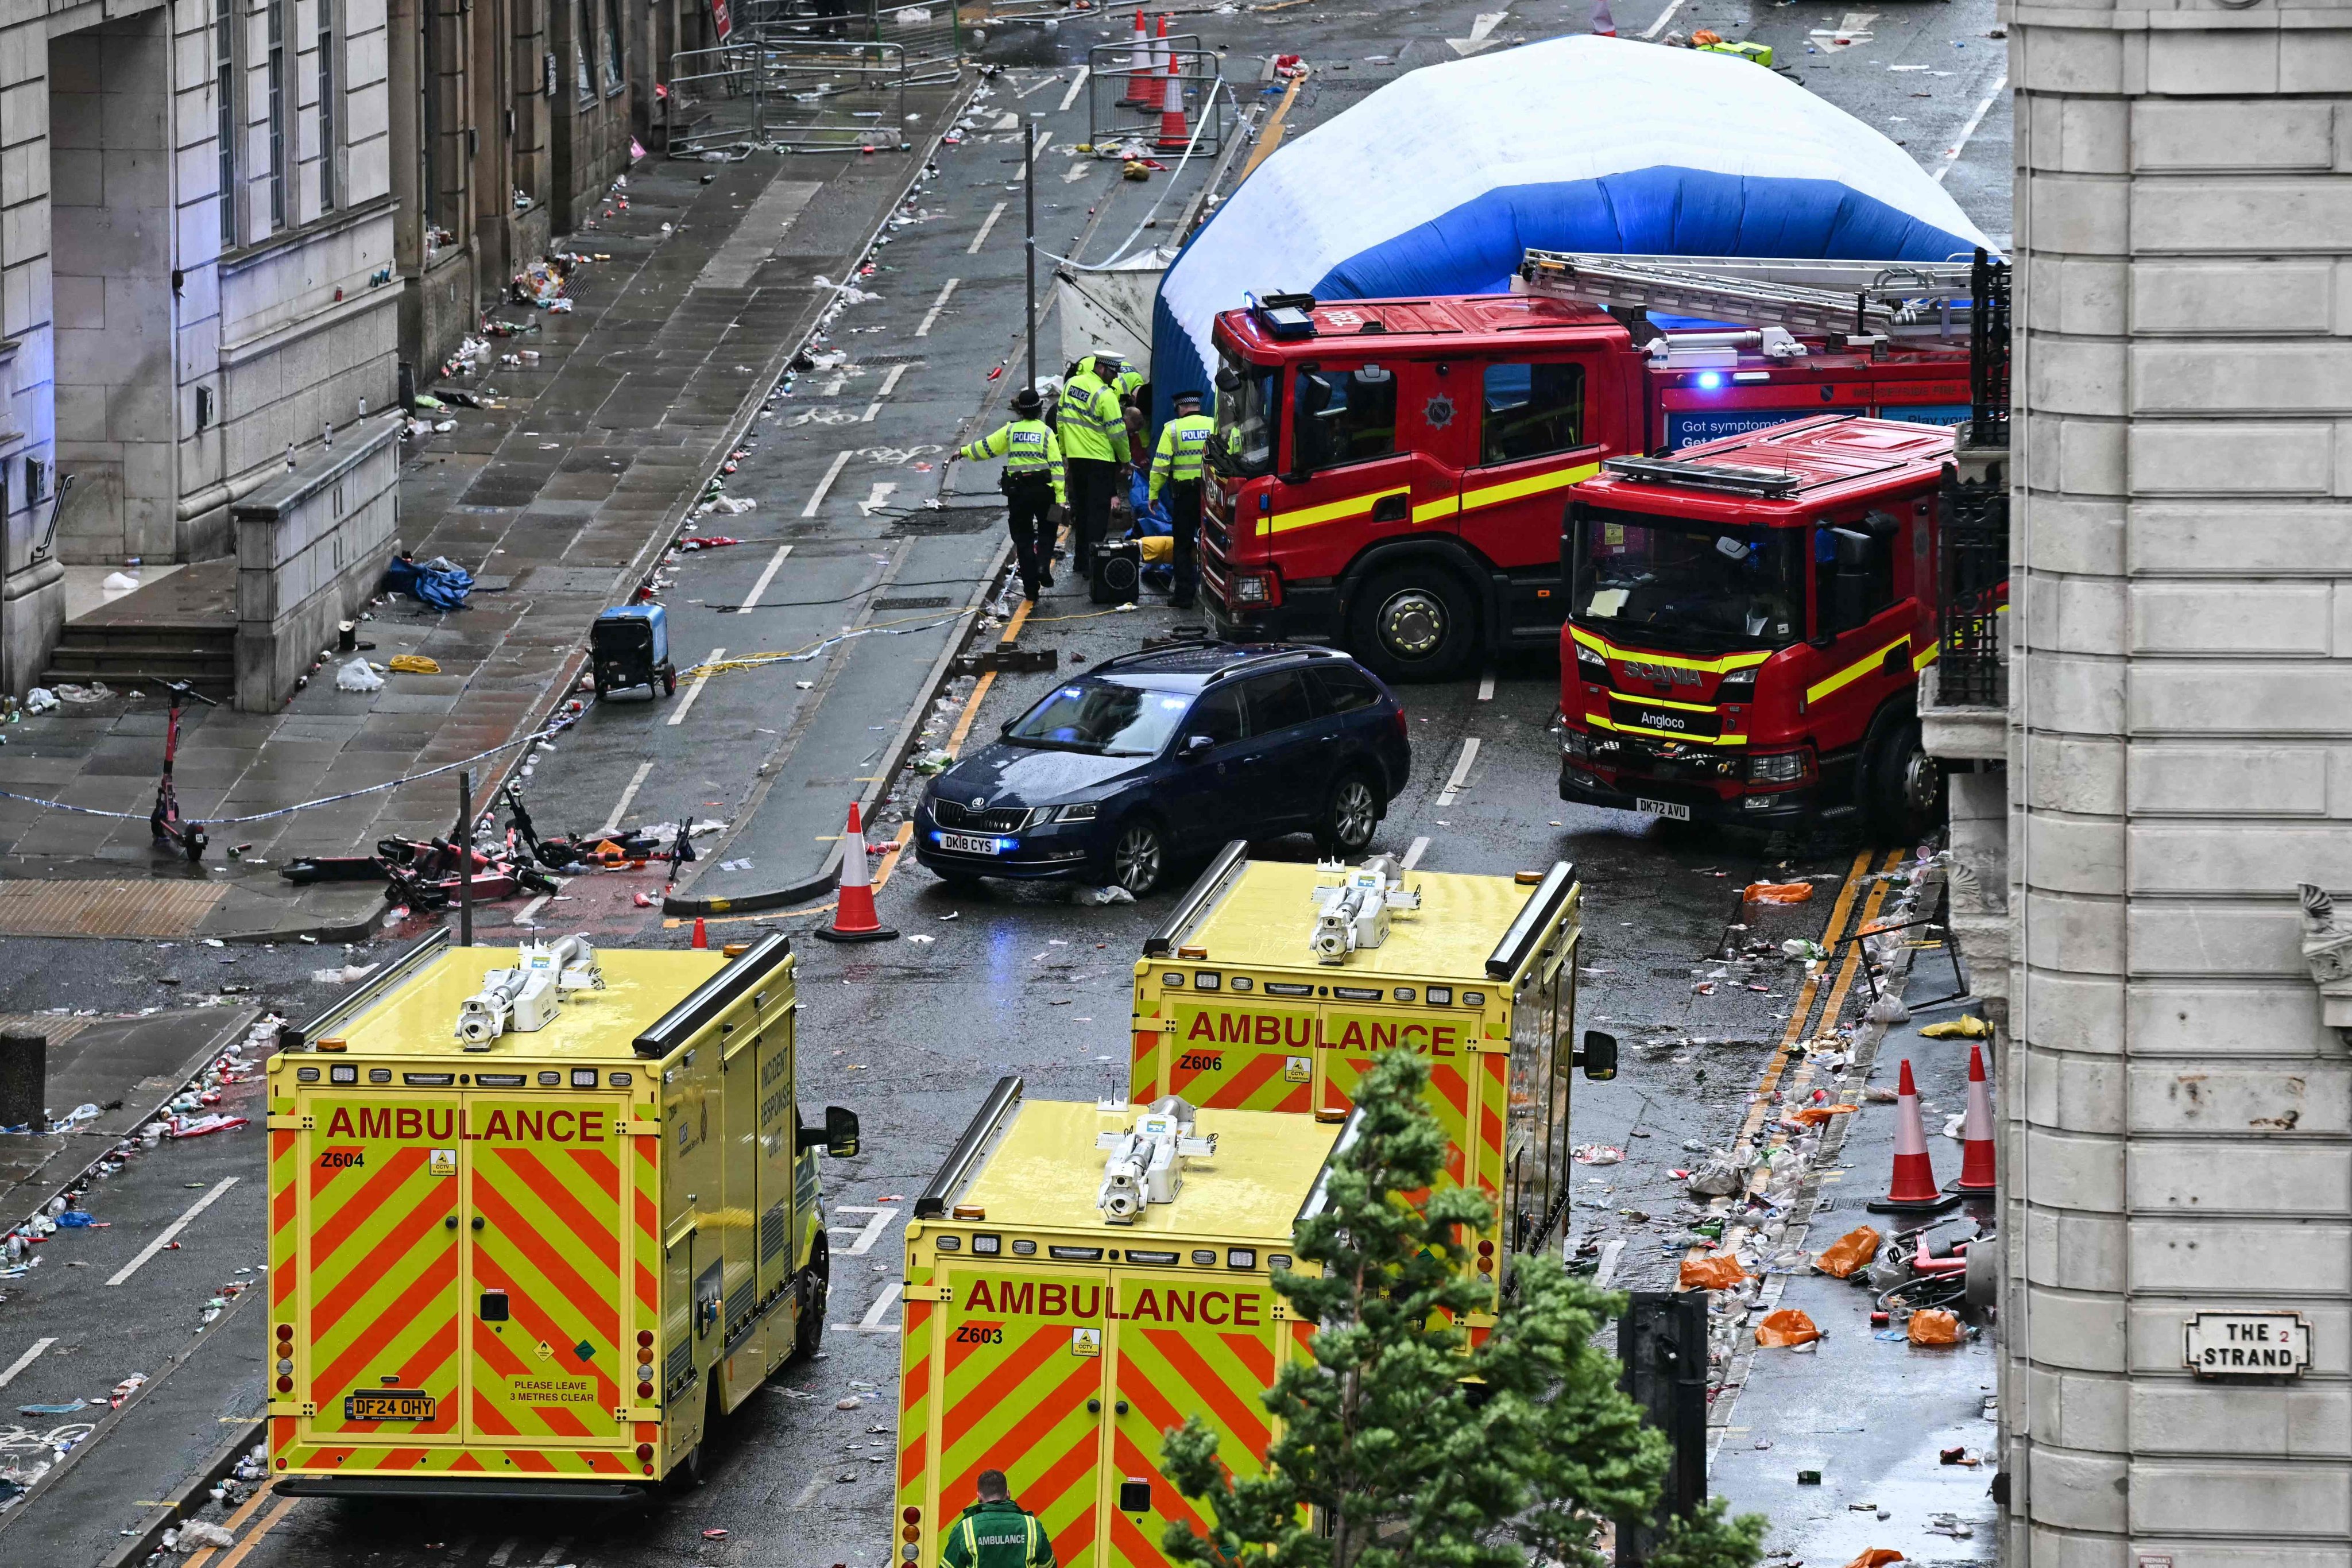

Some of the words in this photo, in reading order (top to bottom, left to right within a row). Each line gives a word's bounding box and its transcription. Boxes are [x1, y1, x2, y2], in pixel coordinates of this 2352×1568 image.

[1069, 387, 1089, 401] POLICE
[1682, 421, 1707, 432] Got
[1711, 419, 1786, 433] symptoms?
[1908, 416, 1939, 425] Play
[1013, 433, 1040, 442] POLICE
[1624, 661, 1703, 687] SCANIA
[1641, 712, 1685, 729] Angloco
[1641, 800, 1665, 814] DK72
[1668, 806, 1685, 817] AVU
[946, 836, 968, 849] DK18
[971, 839, 991, 852] CYS
[1187, 1012, 1456, 1056] AMBULANCE
[762, 1046, 788, 1090] INCIDENT
[1179, 1055, 1222, 1071] Z606
[761, 1082, 791, 1127] RESPONSE
[326, 1107, 604, 1142] AMBULANCE
[768, 1126, 782, 1159] UNIT
[320, 1152, 364, 1167] Z604
[965, 1280, 1260, 1326] AMBULANCE
[956, 1326, 1003, 1344] Z603
[2227, 1324, 2268, 1341] THE
[2280, 1331, 2289, 1342] 2
[2204, 1348, 2292, 1366] STRAND
[514, 1381, 552, 1389] PLEASE
[556, 1382, 586, 1390] LEAVE
[519, 1393, 558, 1401] METRES
[561, 1393, 594, 1401] CLEAR
[355, 1399, 396, 1415] DF24
[401, 1400, 431, 1415] OHY
[978, 1535, 1025, 1546] AMBULANCE
